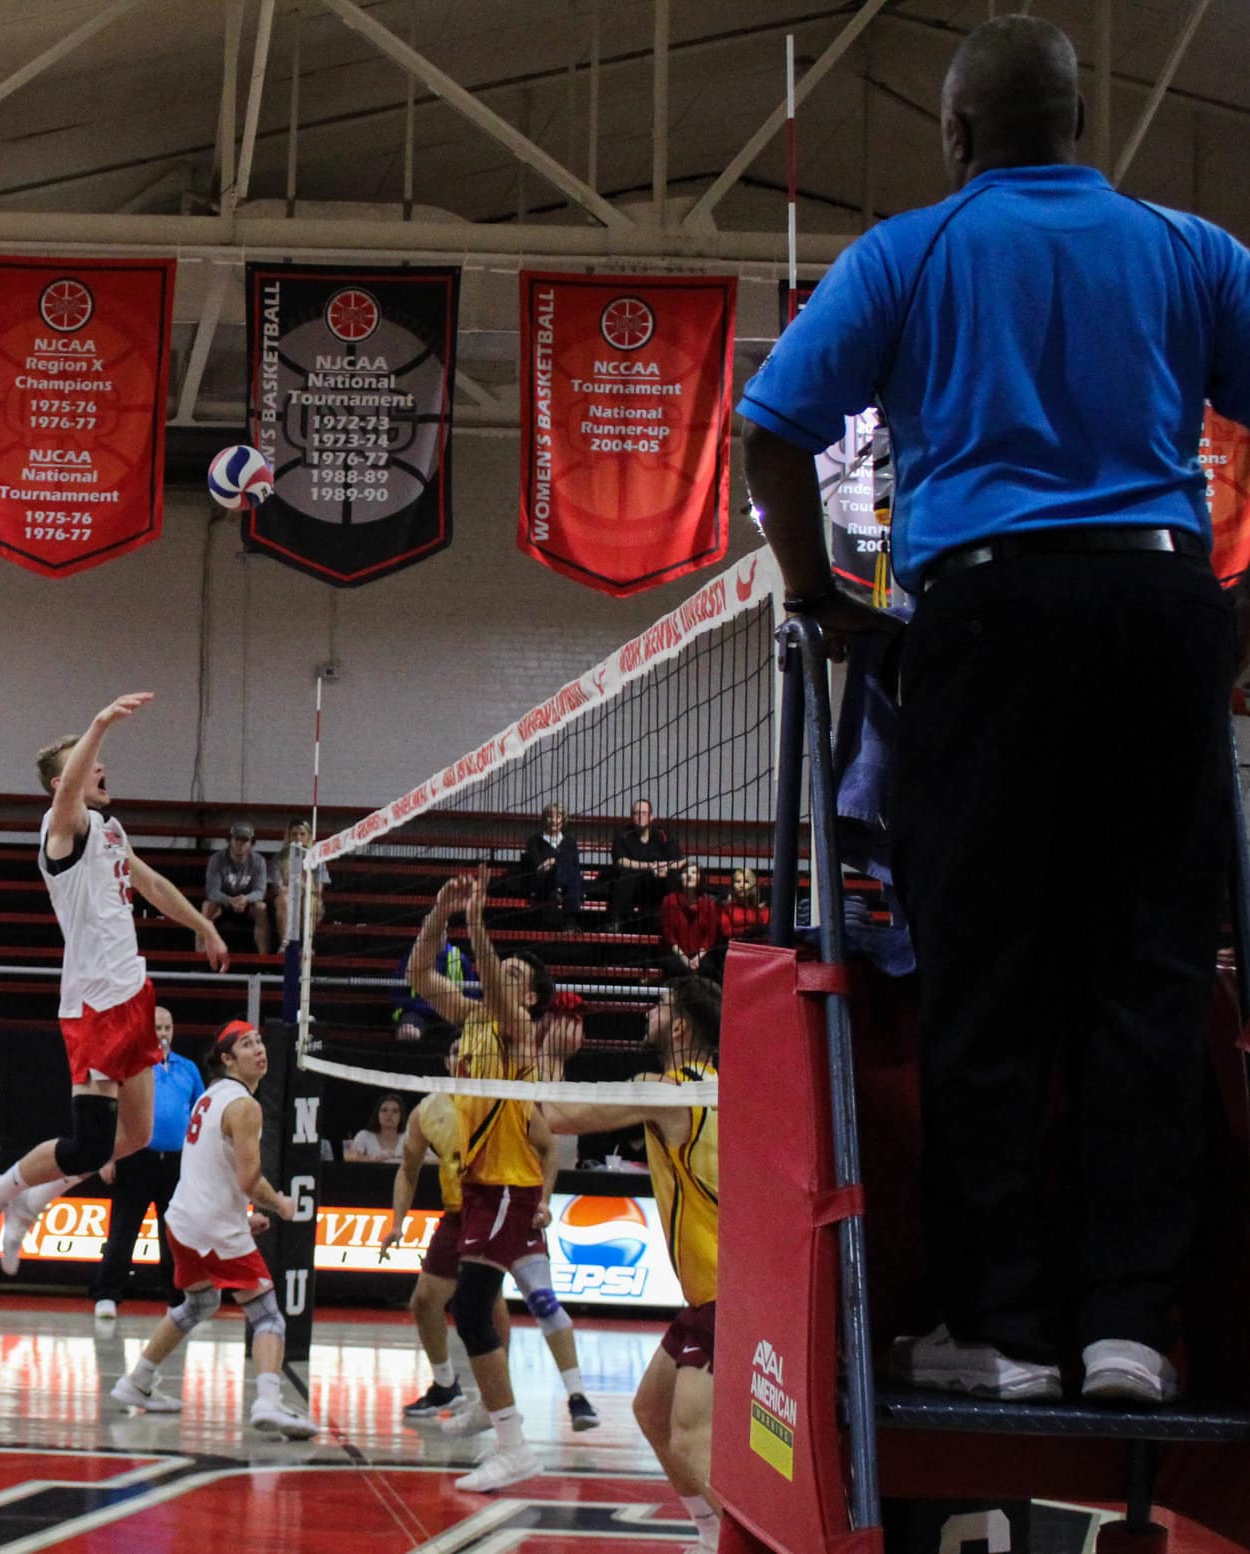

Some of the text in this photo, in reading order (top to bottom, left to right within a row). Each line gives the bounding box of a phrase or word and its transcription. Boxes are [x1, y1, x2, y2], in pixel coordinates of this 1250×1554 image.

[33, 338, 97, 352] NJCAA
[261, 280, 281, 423] BASKETBALL
[25, 357, 104, 374] Region X
[315, 355, 388, 371] NJCAA
[593, 360, 660, 376] NCCAA
[14, 376, 113, 394] Champions
[307, 373, 396, 390] National
[571, 378, 683, 396] Tournament
[29, 398, 98, 413] 1975-76
[287, 390, 416, 408] Tournament
[534, 288, 555, 542] WOMEN'S BASKETBALL
[589, 404, 663, 420] National
[29, 416, 97, 430] 1976-77
[311, 415, 391, 431] 1972-73
[580, 422, 671, 440] Runner-up
[311, 433, 390, 448] 1973-74
[590, 438, 661, 452] 2004-05
[28, 449, 92, 464] NJCAA
[311, 451, 390, 466] 1976-77
[21, 467, 98, 484] National
[310, 469, 390, 484] 1988-89
[310, 486, 389, 502] 1989-90
[24, 510, 93, 525] 1975-76
[24, 526, 92, 541] 1976-77
[750, 1370, 798, 1429] AMERICAN
